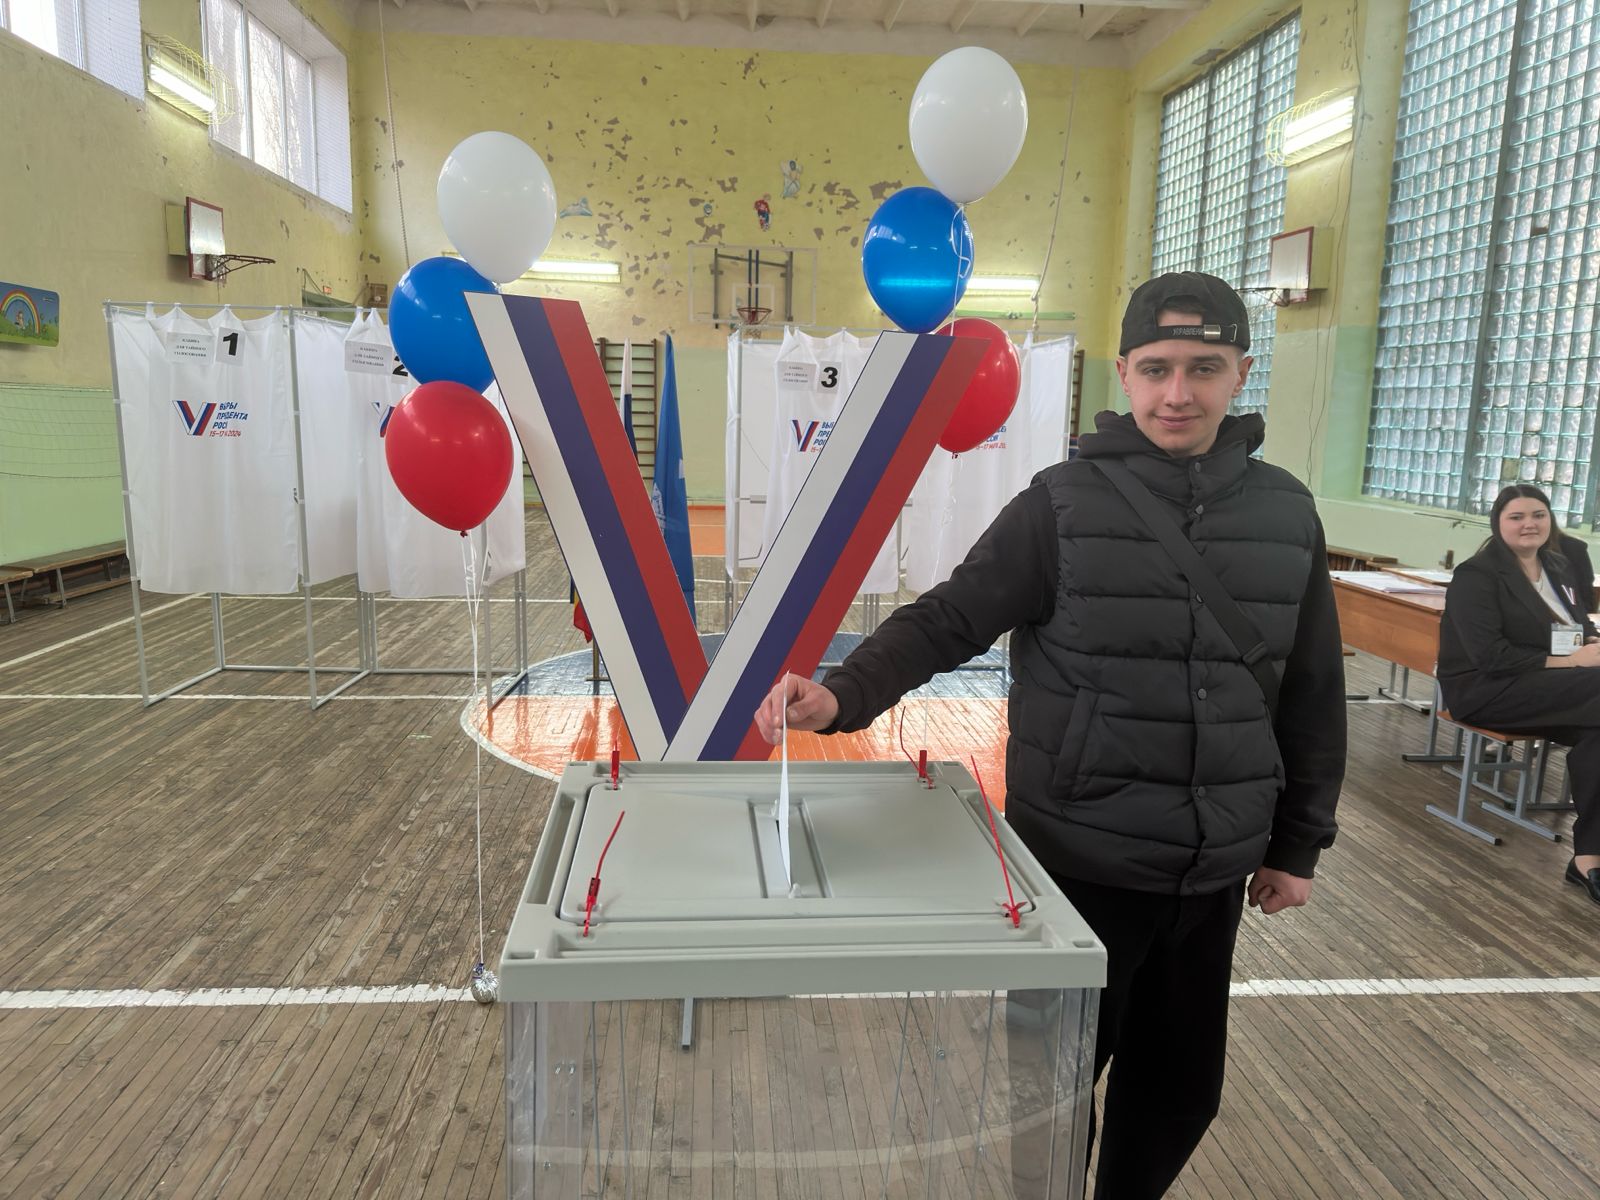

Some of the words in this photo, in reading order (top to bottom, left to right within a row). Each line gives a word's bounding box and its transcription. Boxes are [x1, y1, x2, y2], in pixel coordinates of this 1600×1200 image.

[223, 332, 239, 356] 1
[392, 356, 409, 377] 2
[821, 366, 838, 388] 3
